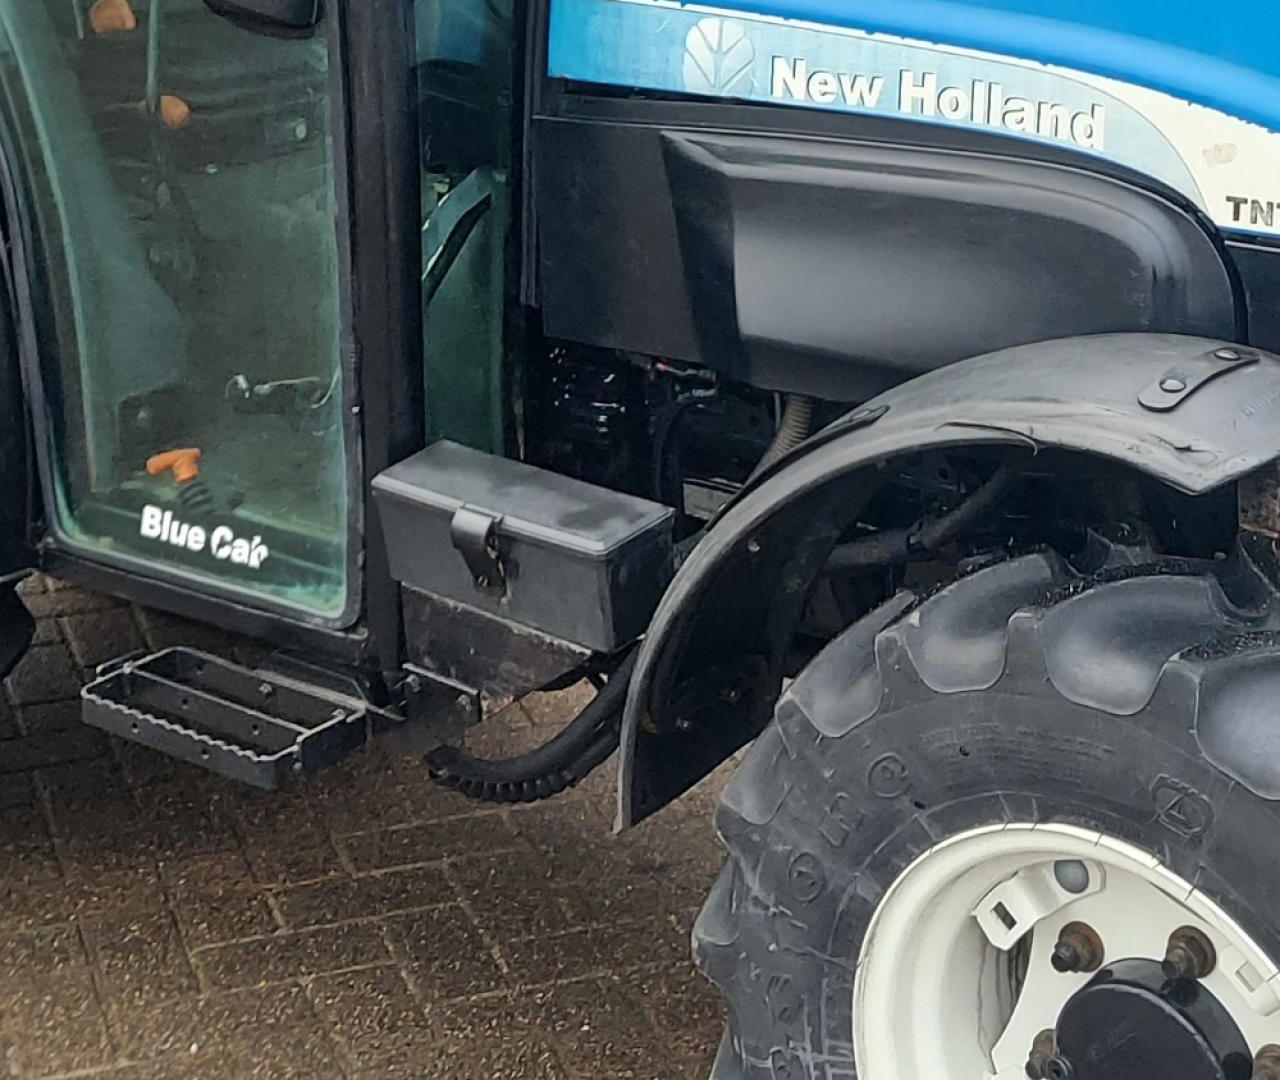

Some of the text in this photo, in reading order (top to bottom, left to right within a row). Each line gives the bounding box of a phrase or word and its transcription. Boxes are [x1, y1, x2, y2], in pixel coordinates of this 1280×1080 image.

[771, 55, 1105, 151] New Holland
[140, 504, 206, 551] Blue
